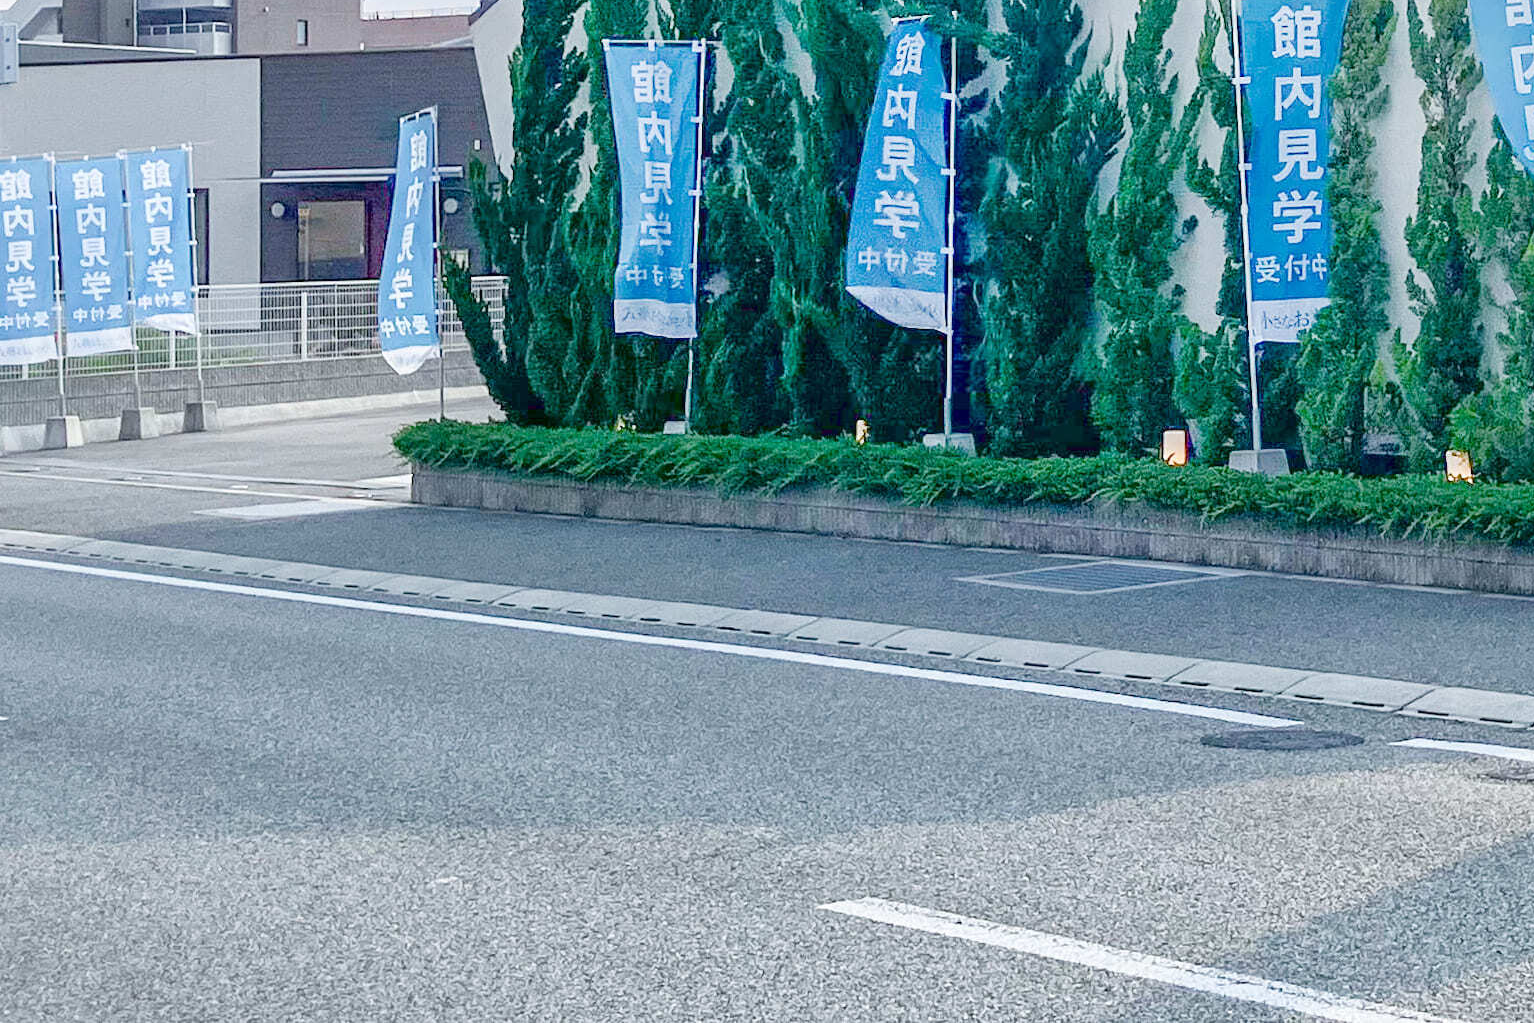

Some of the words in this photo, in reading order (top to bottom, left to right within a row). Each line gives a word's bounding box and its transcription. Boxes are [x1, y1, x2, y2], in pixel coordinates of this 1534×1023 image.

[1271, 5, 1324, 244] 館内見学
[1256, 253, 1327, 283] 受付中
